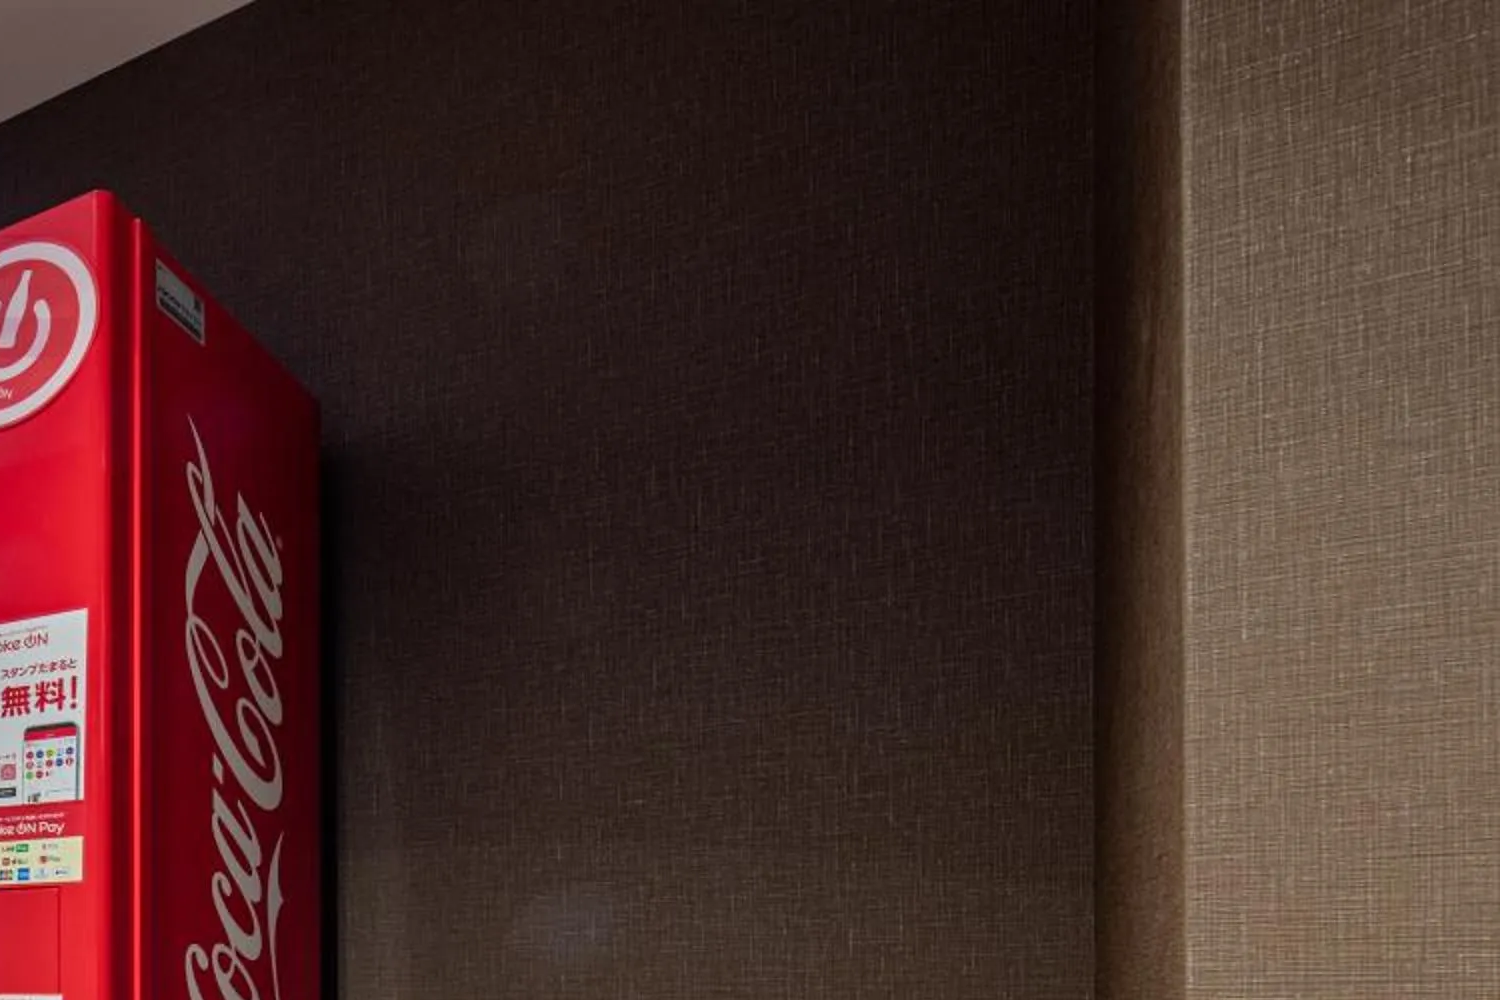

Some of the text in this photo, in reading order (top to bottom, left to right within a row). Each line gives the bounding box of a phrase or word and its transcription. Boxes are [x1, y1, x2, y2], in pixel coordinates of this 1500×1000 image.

[24, 631, 49, 649] ON
[2, 658, 77, 679] スタンプたまると
[16, 821, 37, 835] ON
[39, 820, 66, 836] Pay
